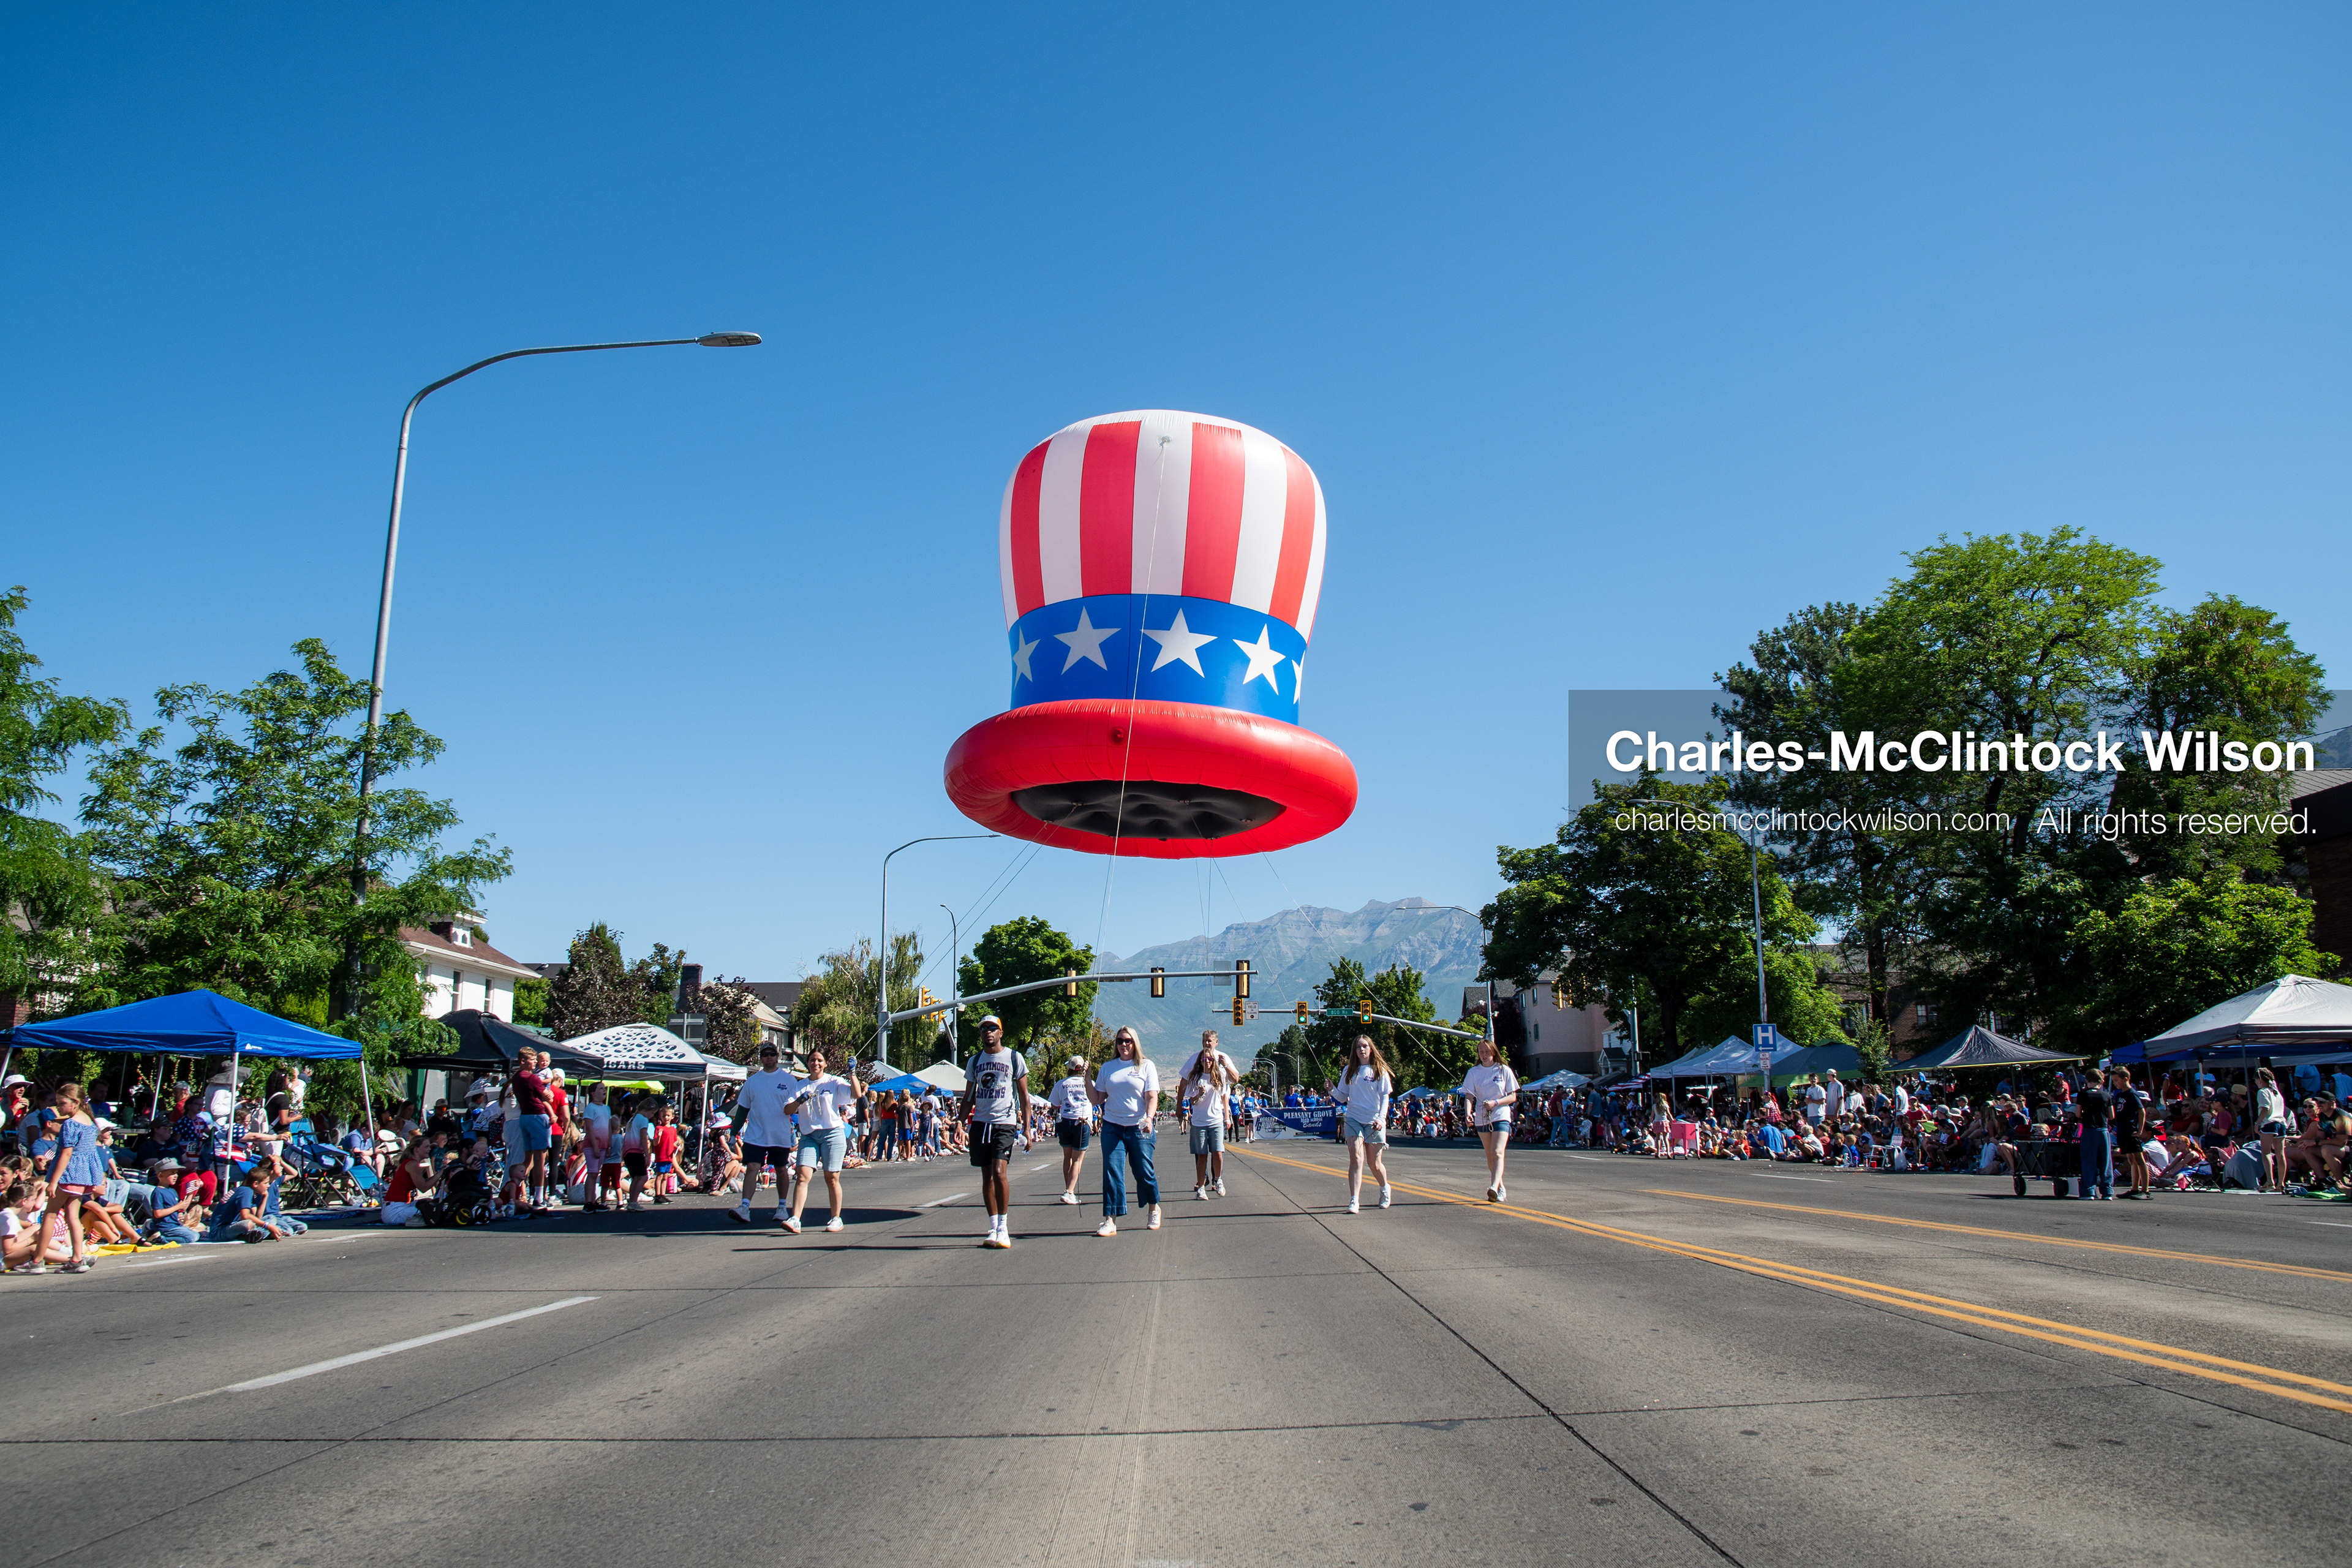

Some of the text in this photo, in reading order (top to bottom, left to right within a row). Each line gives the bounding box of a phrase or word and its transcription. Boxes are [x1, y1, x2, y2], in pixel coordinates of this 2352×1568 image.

[1757, 1026, 1773, 1044] H
[975, 1061, 1009, 1078] BALTIMORE
[1313, 1109, 1333, 1118] GROVE
